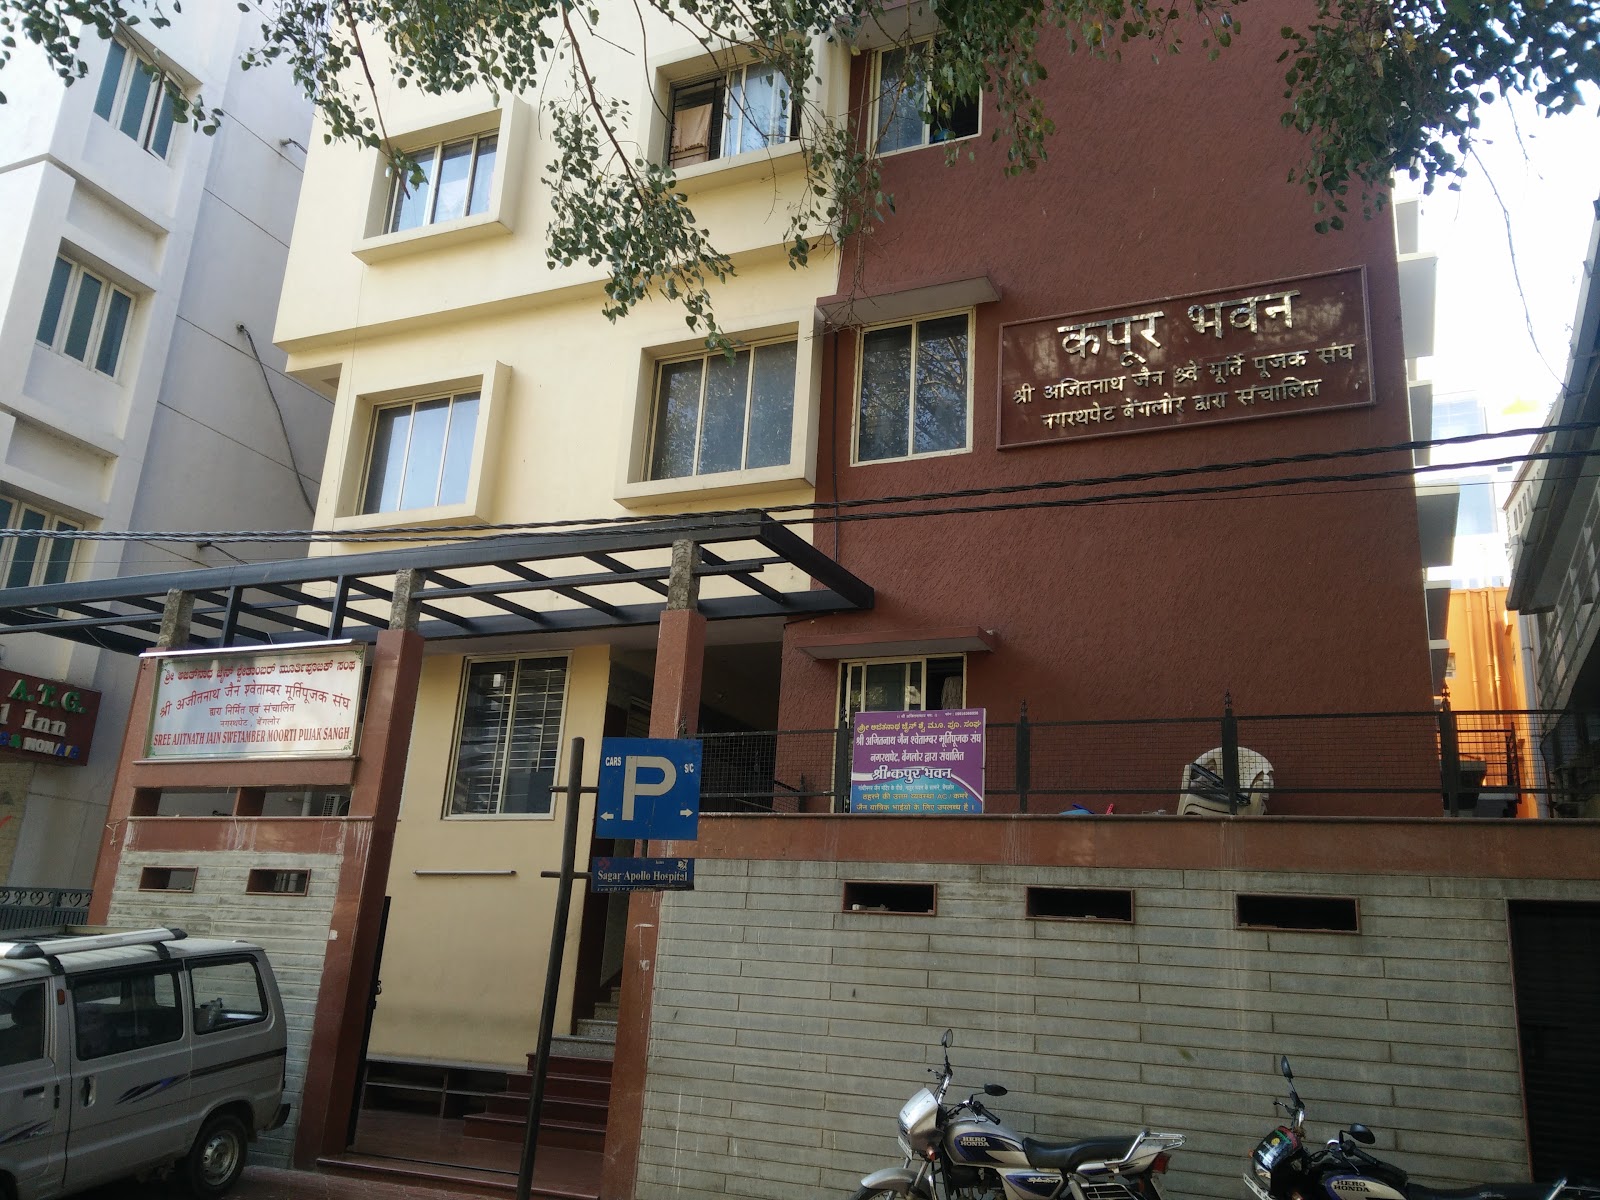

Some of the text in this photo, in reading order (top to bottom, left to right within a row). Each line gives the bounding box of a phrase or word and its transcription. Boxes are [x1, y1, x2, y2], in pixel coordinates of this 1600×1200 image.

[1057, 290, 1300, 367] कपूर भवन
[1013, 383, 1035, 404] श्री
[1043, 375, 1125, 402] अजितनाथ
[1132, 365, 1166, 388] जैन
[1254, 350, 1309, 378] पूजक
[1316, 342, 1355, 364] संघ
[1041, 402, 1116, 430] नगरथपेट
[1194, 391, 1228, 413] द्वारा
[1234, 376, 1323, 406] संचालित
[159, 681, 351, 718] श्री अजीतनाथ जैन श्वेताम्बर मूर्तिपूजक संघ
[248, 703, 261, 716] एवं
[263, 701, 297, 715] संचालित
[21, 708, 67, 737] Inn
[154, 726, 350, 747] SREE AJITNATH JAIN SWETAMBER MOORTI PUJAK SANGH
[856, 733, 864, 746] श्री
[897, 732, 909, 745] जैन
[970, 731, 982, 744] संघ
[605, 756, 622, 767] CARS
[939, 748, 965, 762] संचालित
[872, 765, 889, 780] श्री
[922, 767, 952, 779] भवन
[621, 755, 677, 821] P
[597, 870, 688, 883] Sagar Apollo Hospital
